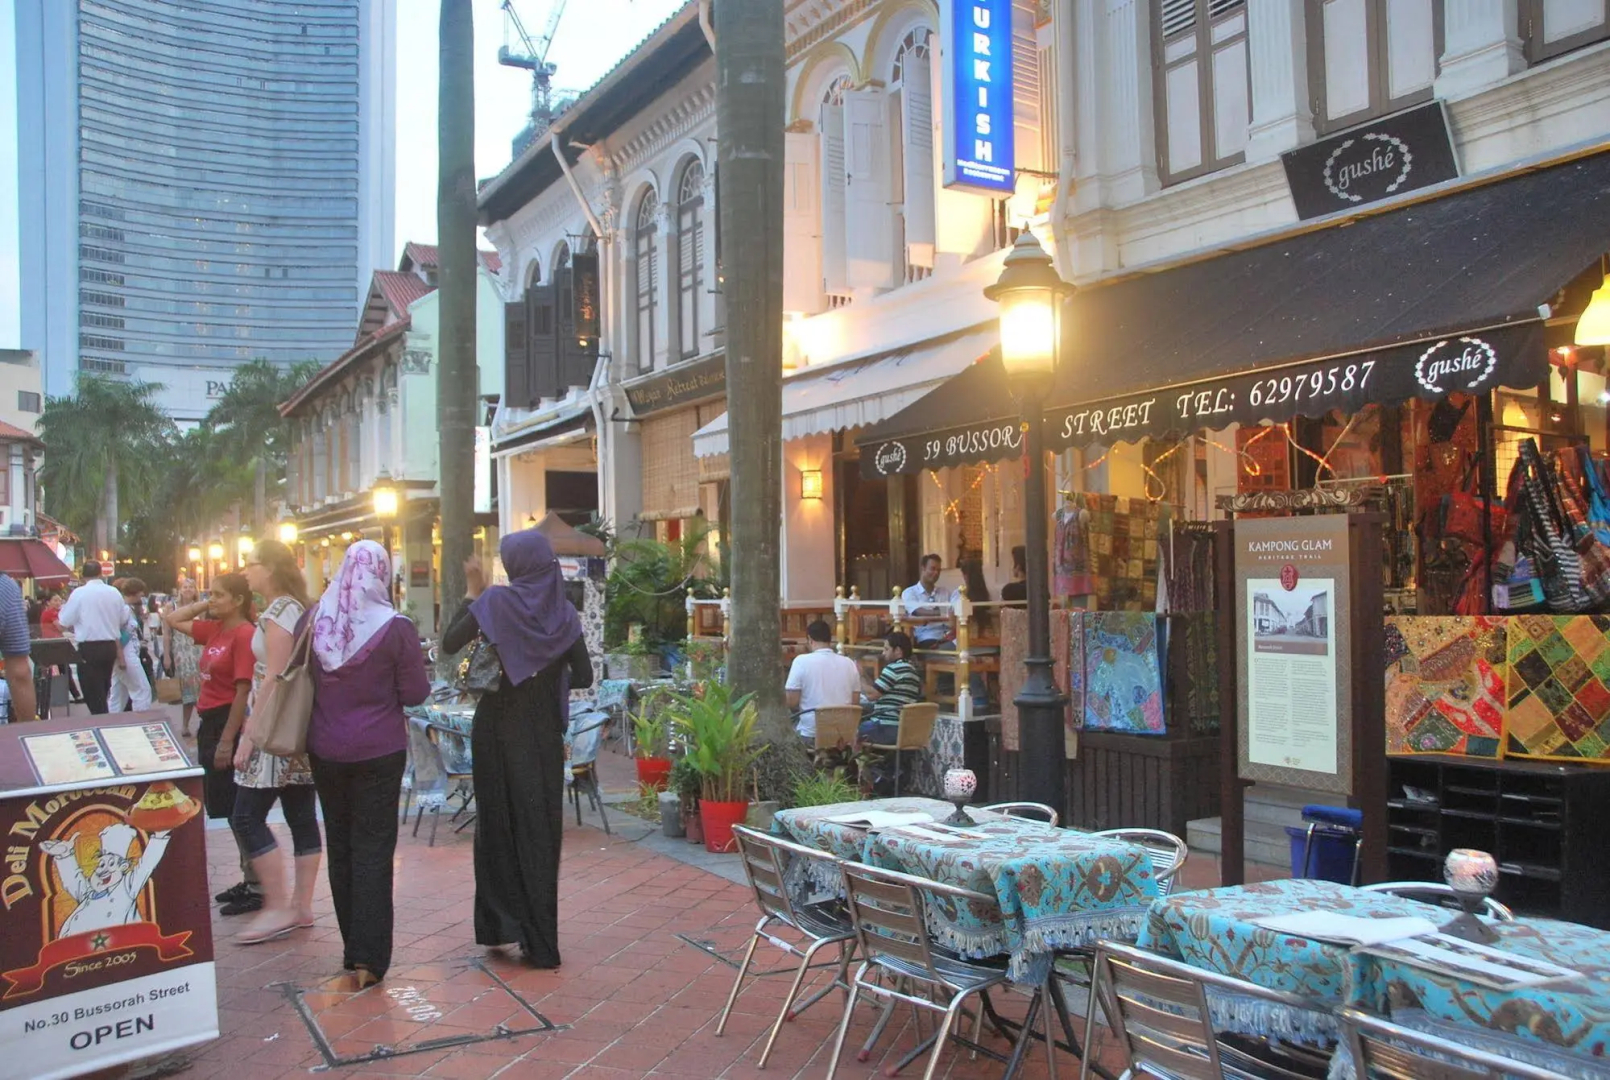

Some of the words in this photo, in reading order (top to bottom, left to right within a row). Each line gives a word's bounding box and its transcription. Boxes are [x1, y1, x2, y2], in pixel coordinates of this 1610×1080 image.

[973, 0, 993, 162] URKISH
[1338, 146, 1395, 190] gushé
[1427, 347, 1482, 384] gushé
[923, 440, 941, 460] 59
[945, 425, 1024, 456] BUSSOR
[1061, 398, 1156, 438] STREET
[1176, 387, 1235, 420] TEL:
[1249, 361, 1376, 408] 62979587
[1248, 540, 1299, 552] KAMPONG
[1301, 539, 1332, 551] GLAM
[1, 845, 33, 910] Deli
[63, 961, 102, 979] Since
[105, 952, 137, 967] 2005
[24, 1011, 69, 1033] No.30
[74, 993, 145, 1020] Bussorah
[149, 982, 190, 1001] Street
[70, 1014, 154, 1051] OPEN
